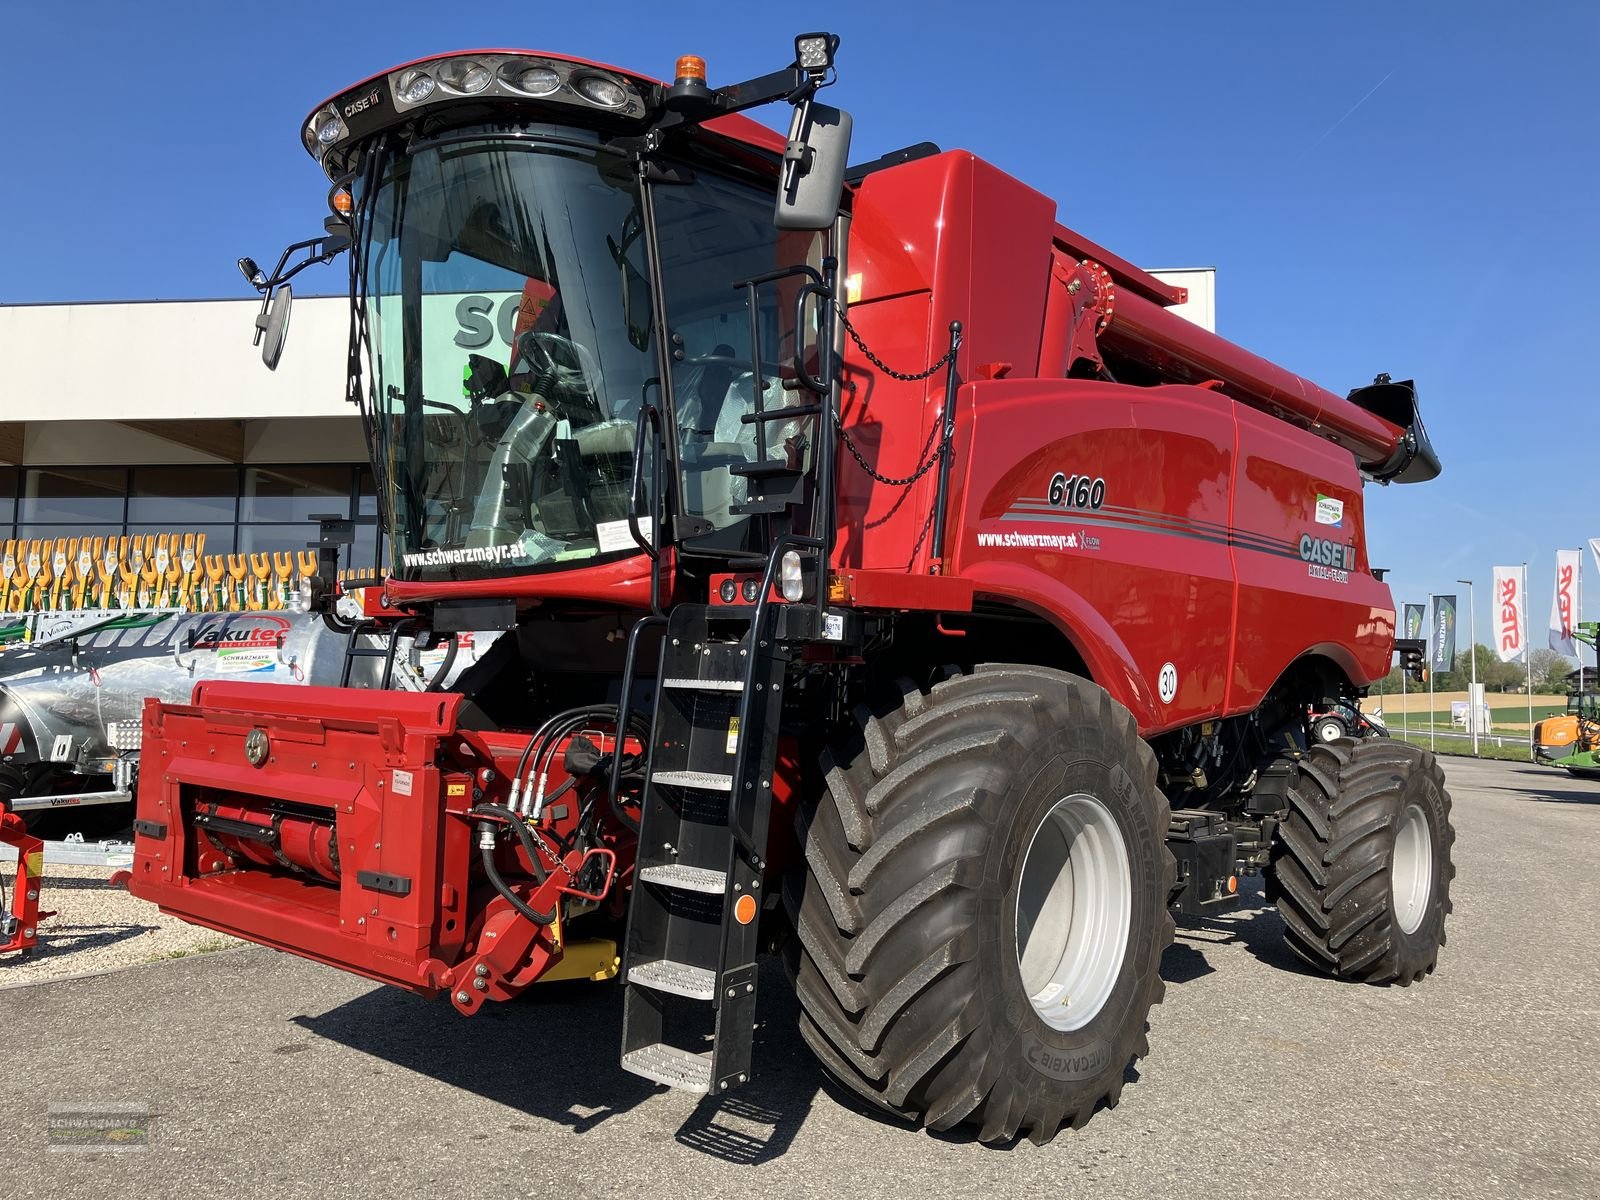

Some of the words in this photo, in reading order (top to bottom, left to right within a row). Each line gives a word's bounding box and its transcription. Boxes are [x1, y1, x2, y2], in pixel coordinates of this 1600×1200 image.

[344, 97, 370, 117] CASE
[1047, 472, 1106, 511] 6160
[977, 531, 1078, 550] www.schwarzmayr.at
[1299, 533, 1342, 568] CASE
[403, 540, 527, 567] www.schwarzmayr.at
[187, 624, 290, 649] Vakutec
[1162, 671, 1175, 696] 30
[1041, 1048, 1108, 1073] MEGAXBIB
